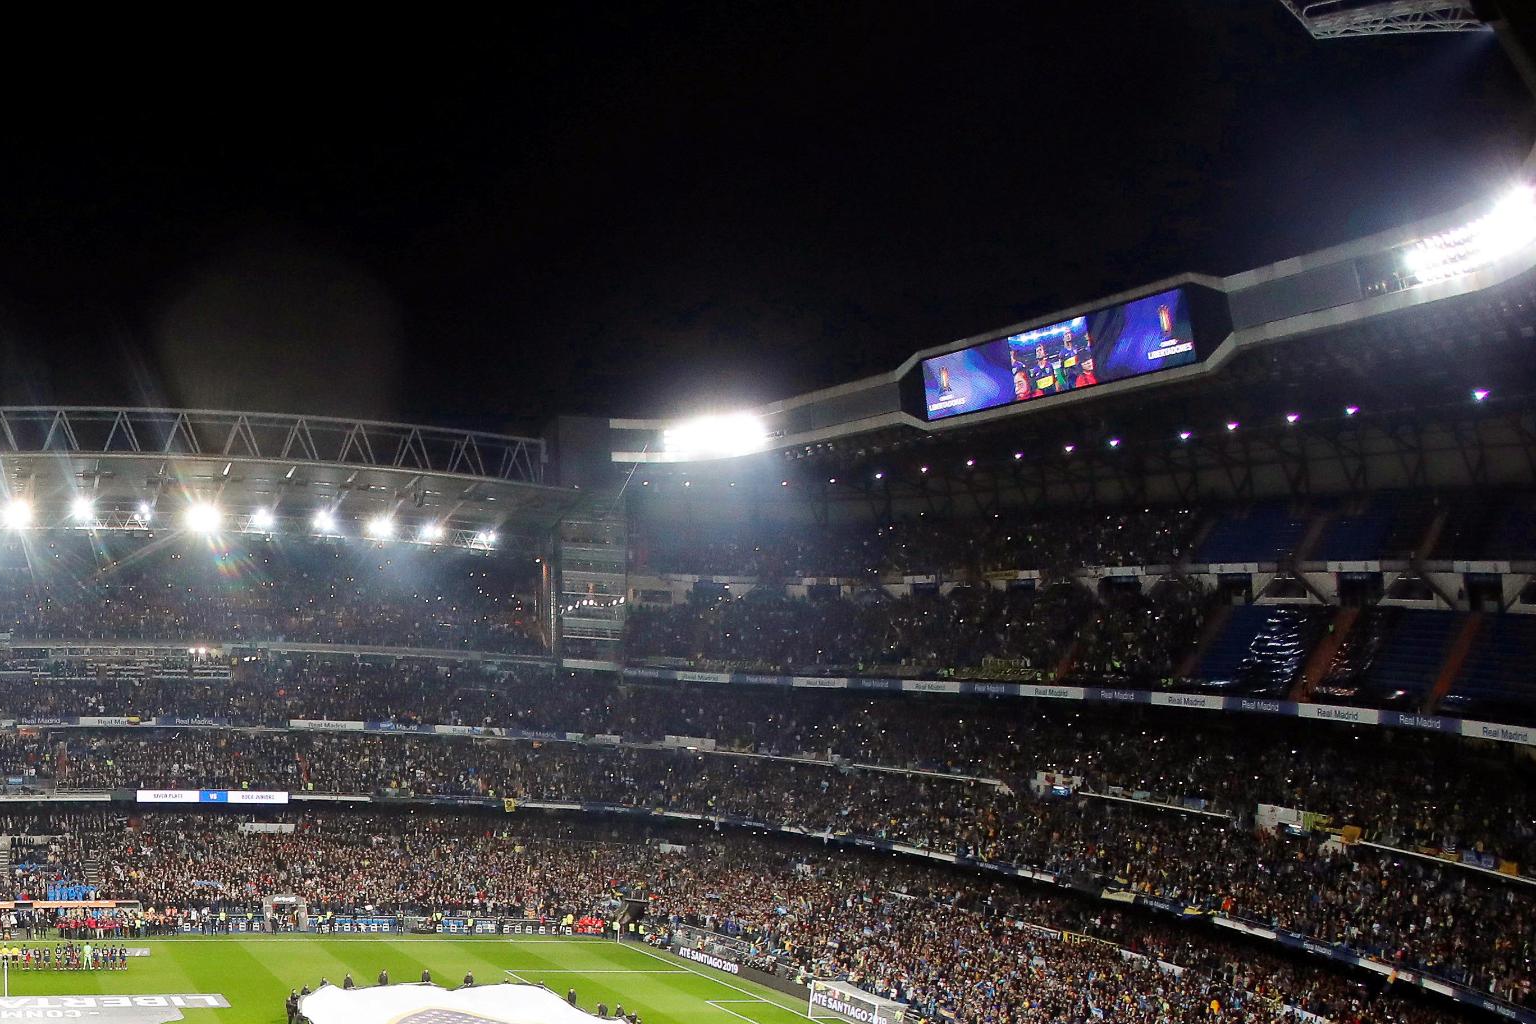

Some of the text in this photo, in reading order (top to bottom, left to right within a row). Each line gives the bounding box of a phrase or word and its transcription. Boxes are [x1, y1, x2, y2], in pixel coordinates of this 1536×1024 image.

[1035, 688, 1068, 697] Real Madrid
[1100, 690, 1134, 700] Real Madrid
[1168, 697, 1205, 707] Real Madrid
[1241, 700, 1279, 712] Real Madrid
[1317, 709, 1358, 721] Real Madrid
[1399, 715, 1441, 729] Real Madrid
[1482, 727, 1528, 742] Real Madrid
[691, 951, 722, 969] SANTIAGO
[722, 961, 739, 974] 2019
[827, 998, 868, 1021] SANTIAGO
